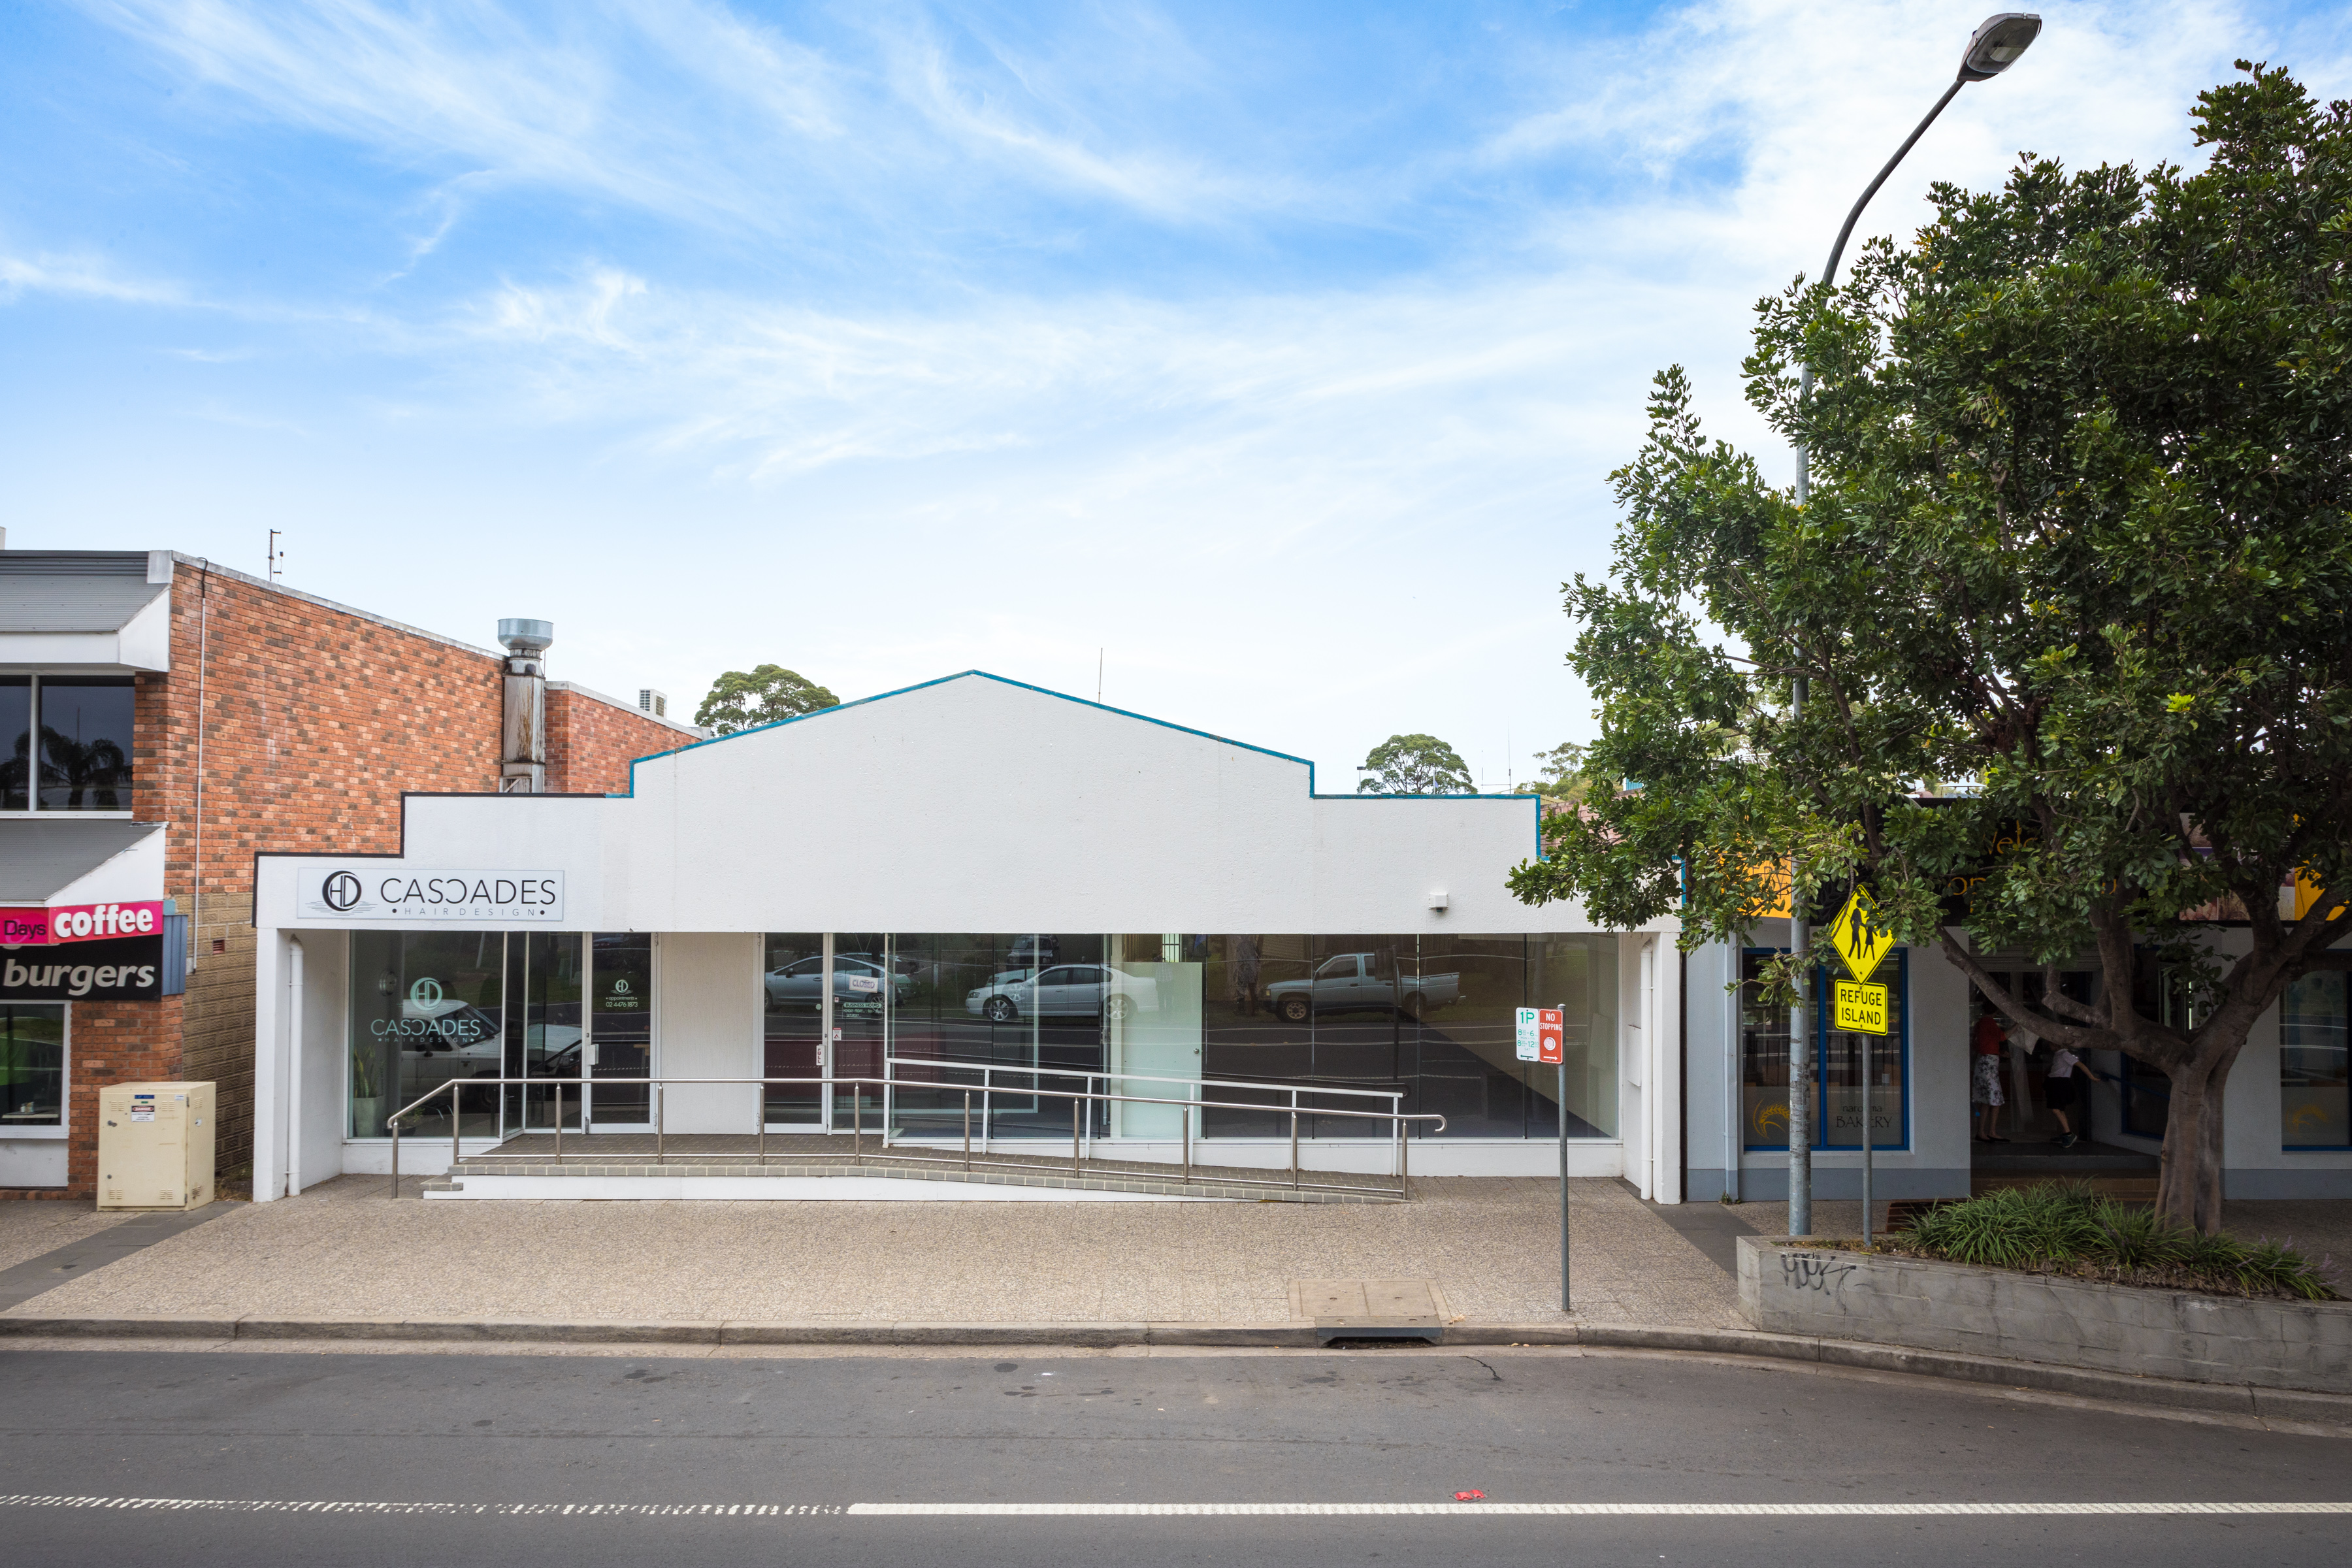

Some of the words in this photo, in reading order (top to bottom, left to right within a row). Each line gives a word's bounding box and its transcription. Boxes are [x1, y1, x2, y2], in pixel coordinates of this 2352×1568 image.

[380, 877, 556, 905] CASCADES
[4, 921, 46, 939] Days
[54, 904, 154, 938] coffee
[3, 958, 155, 996] burgers
[853, 979, 875, 989] CLOSED
[1840, 988, 1882, 1006] REFUGE
[1520, 1011, 1535, 1024] 1P
[1546, 1013, 1555, 1022] NO
[1842, 1007, 1881, 1025] ISLAND
[370, 1019, 480, 1036] CASCADES
[1539, 1022, 1562, 1031] STOPPING
